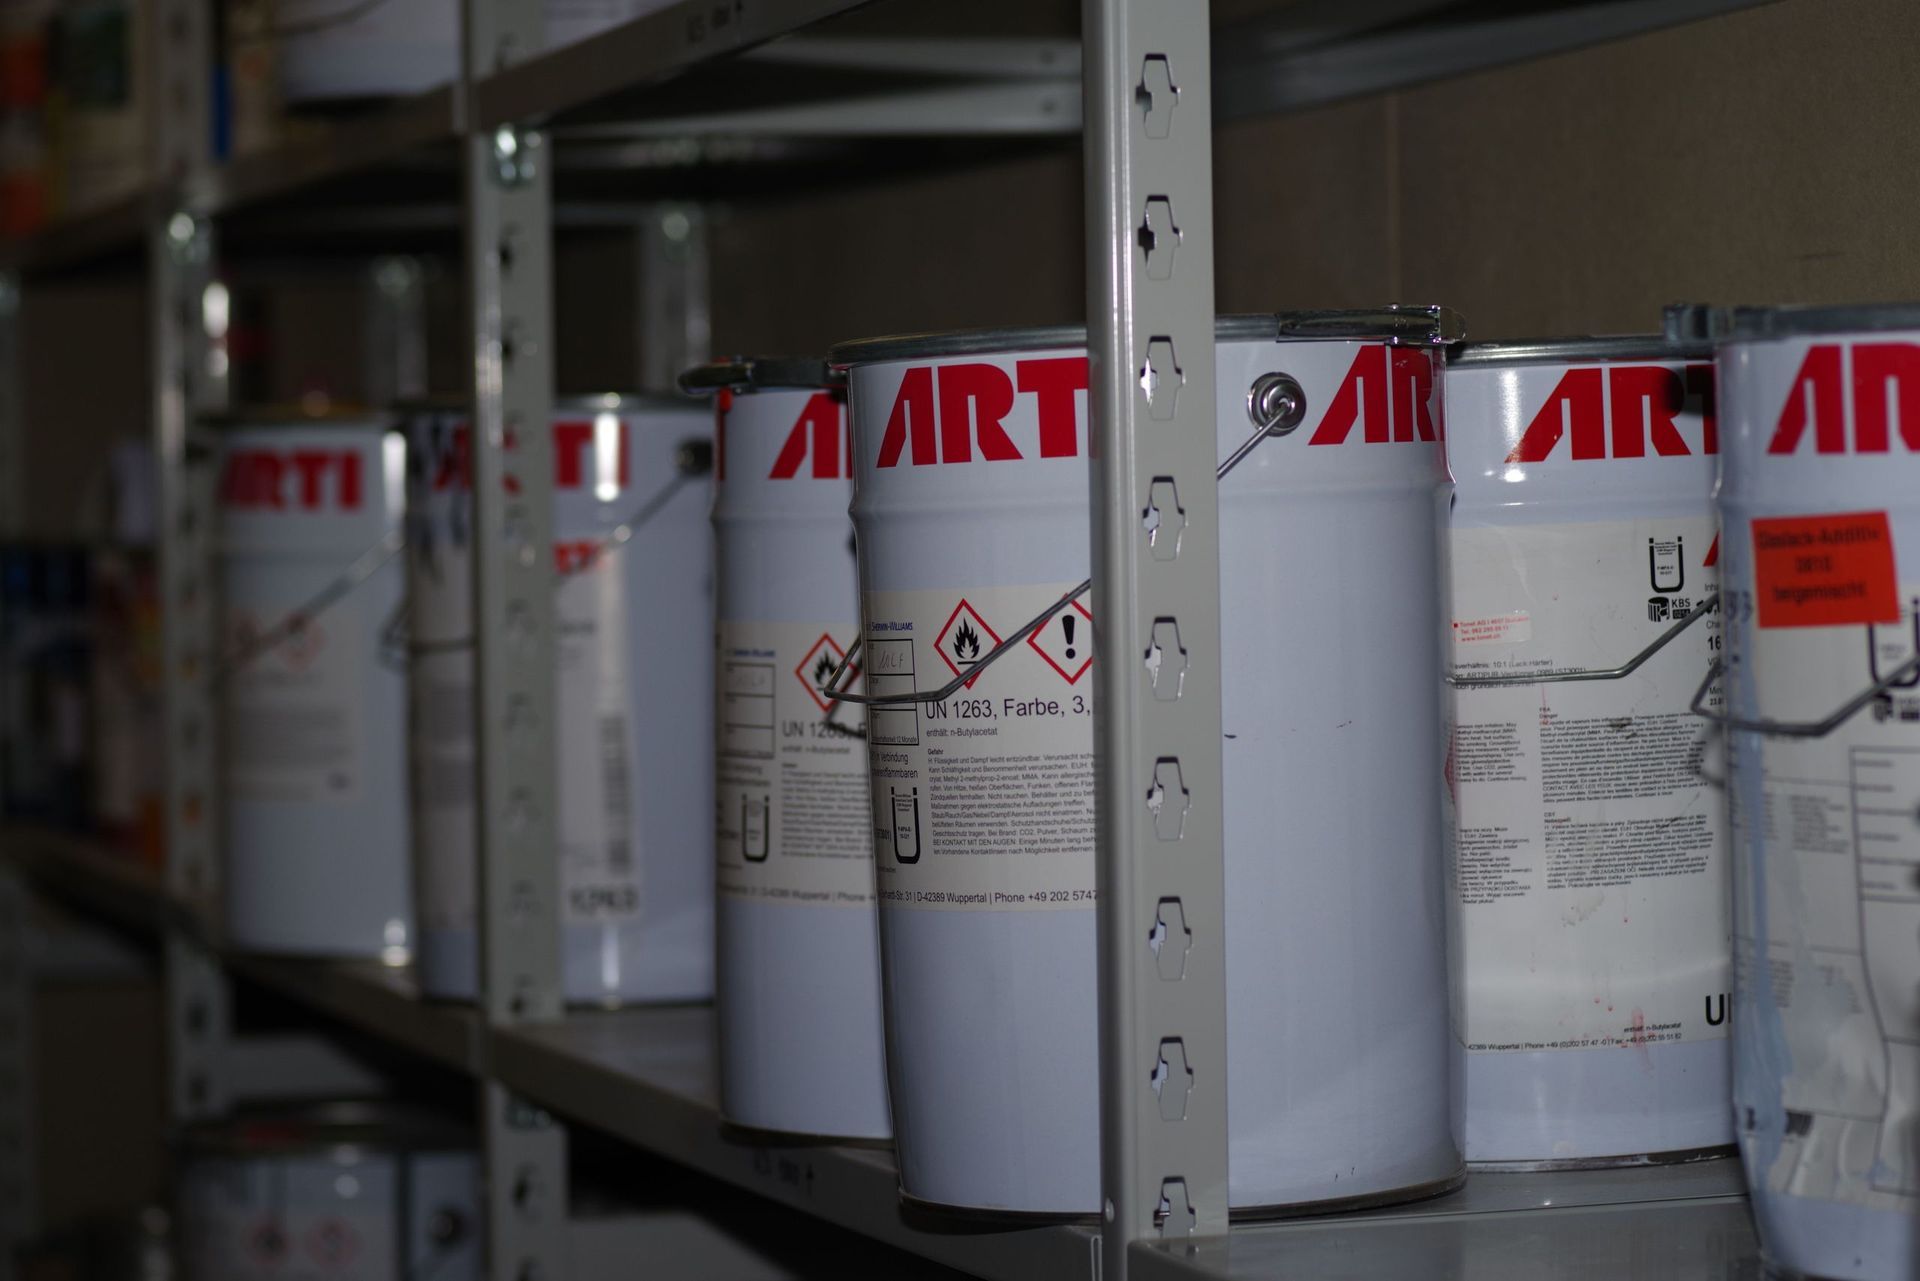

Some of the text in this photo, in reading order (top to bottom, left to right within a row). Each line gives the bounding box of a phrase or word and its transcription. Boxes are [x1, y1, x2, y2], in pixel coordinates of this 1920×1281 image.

[1671, 599, 1690, 608] KBS
[925, 700, 947, 719] UN
[953, 700, 997, 720] 1263,
[1003, 698, 1064, 717] Farbe,
[950, 728, 998, 738] n-Butylacetat
[917, 891, 945, 903] D-42389
[947, 892, 987, 905] Wuppertal
[995, 892, 1025, 903] Phone
[1028, 891, 1047, 901] +49
[1050, 891, 1069, 901] 202
[1488, 1043, 1519, 1051] Wuppertal
